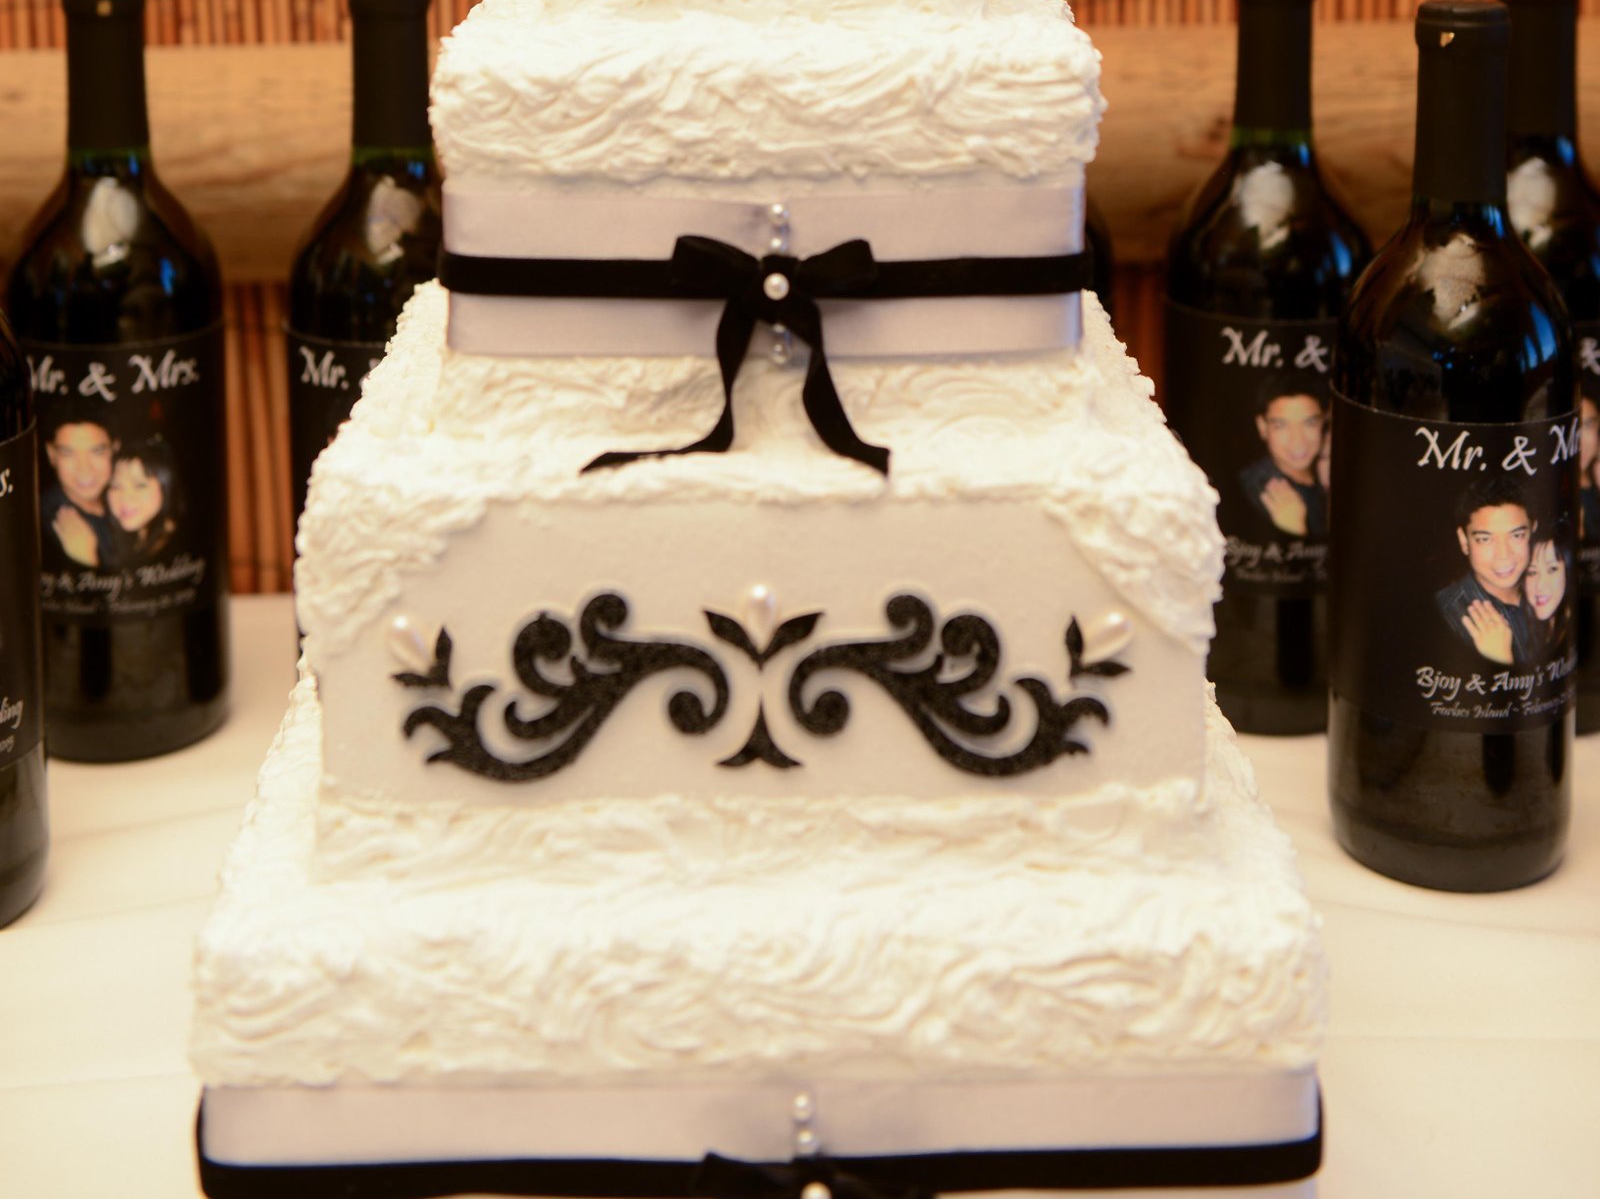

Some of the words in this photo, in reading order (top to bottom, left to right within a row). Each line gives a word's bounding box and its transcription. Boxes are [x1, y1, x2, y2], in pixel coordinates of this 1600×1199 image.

[298, 345, 349, 390] Mr.
[1221, 326, 1284, 368] Mr.
[1294, 335, 1329, 373] &
[78, 361, 117, 402] &
[1415, 426, 1487, 471] Mr.
[1501, 435, 1537, 476] &
[1416, 666, 1461, 701] Bjoy
[1464, 673, 1487, 695] &
[1490, 666, 1544, 700] Amy's
